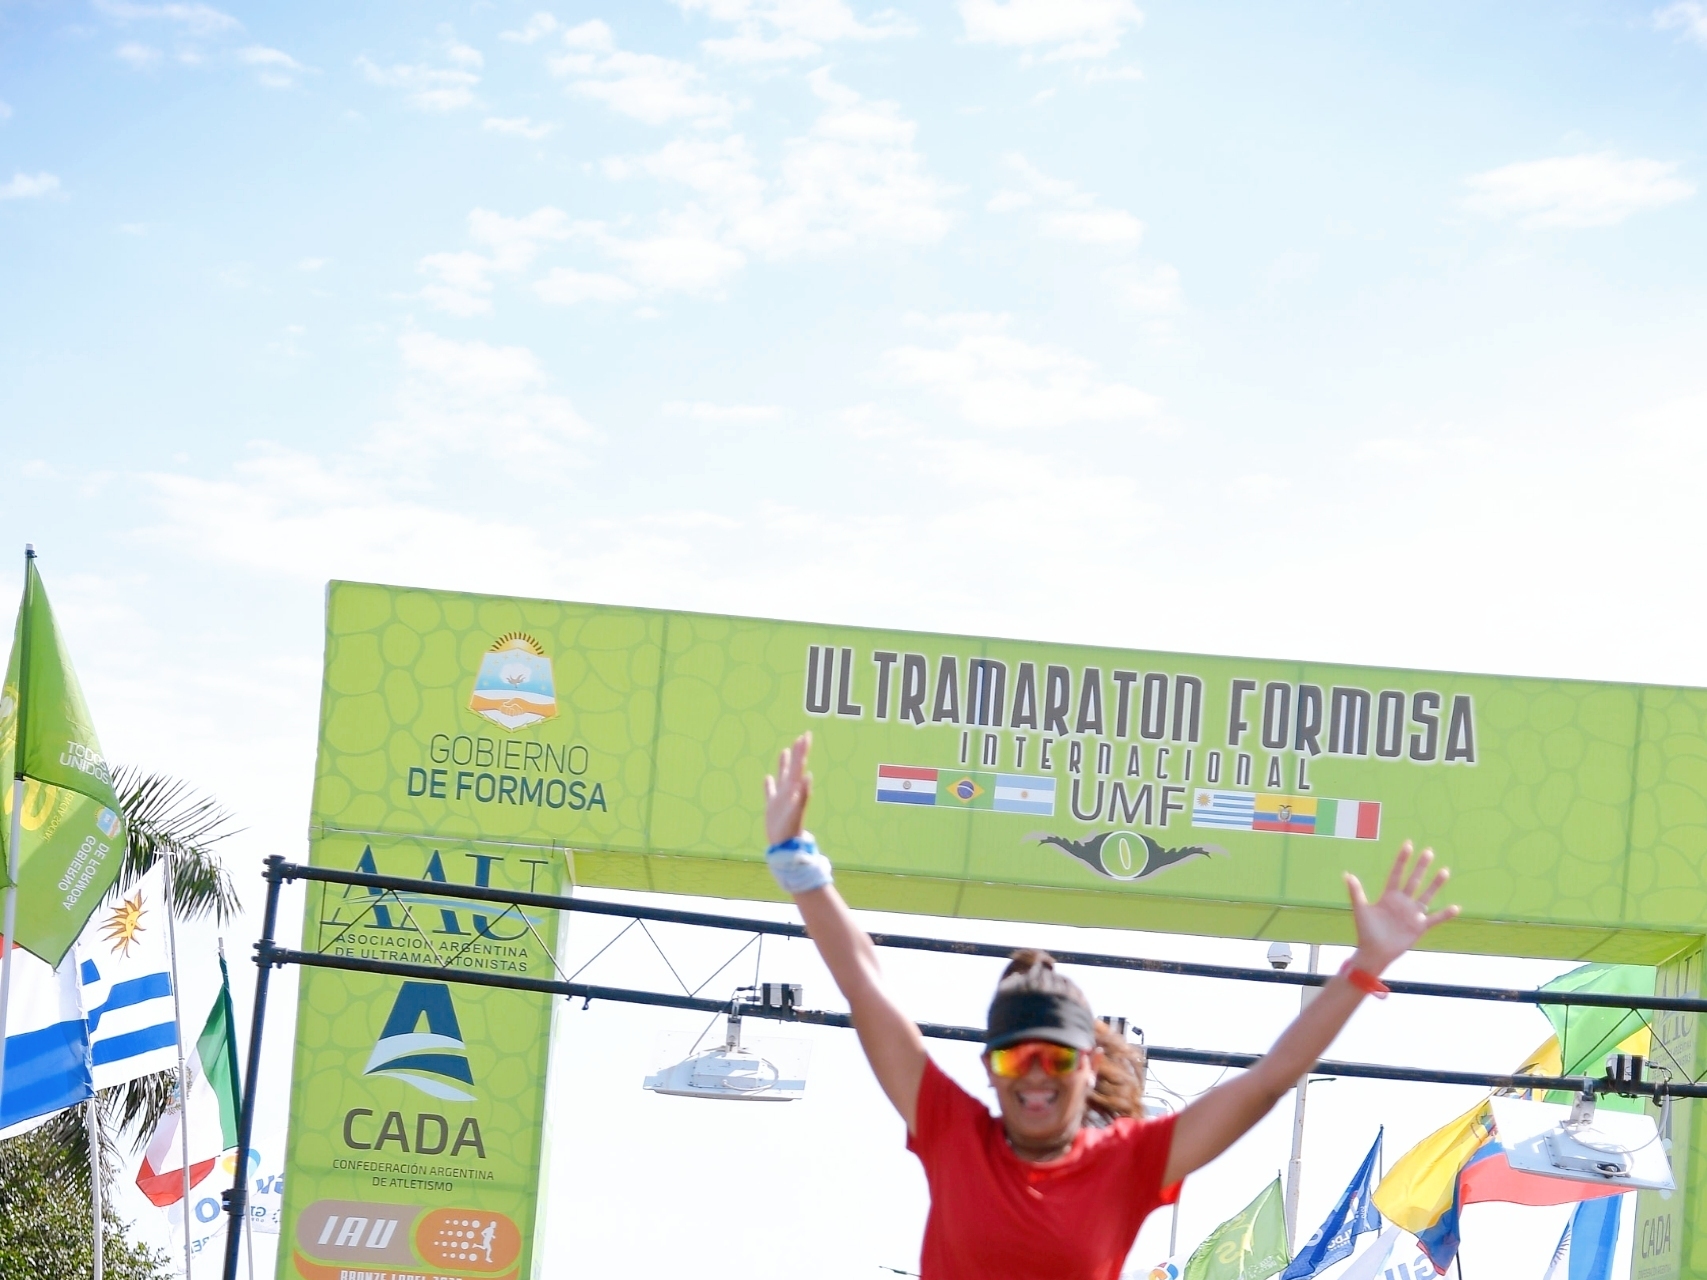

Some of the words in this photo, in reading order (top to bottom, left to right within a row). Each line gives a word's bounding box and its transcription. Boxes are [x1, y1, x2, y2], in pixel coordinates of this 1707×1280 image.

[805, 645, 1203, 744] ULTRAMARATON
[1229, 679, 1476, 764] FORMOSA
[59, 752, 109, 785] UNIDOS
[430, 733, 589, 775] GOBIERNO
[961, 731, 1313, 791] INTERNACIONAL
[407, 767, 447, 799] DE
[456, 773, 608, 813] FORMOSA
[1072, 779, 1186, 827] UMF
[336, 933, 434, 951] ASOCIACION
[438, 940, 529, 959] ARGENTINA
[343, 1107, 487, 1159] CADA
[332, 1158, 427, 1176] CONFEDERACIÓN
[430, 1166, 495, 1181] ARGENTINA
[372, 1176, 388, 1187] DE
[389, 1177, 454, 1193] ATLETISMO
[317, 1215, 398, 1249] IAU
[1641, 1213, 1671, 1259] CADA
